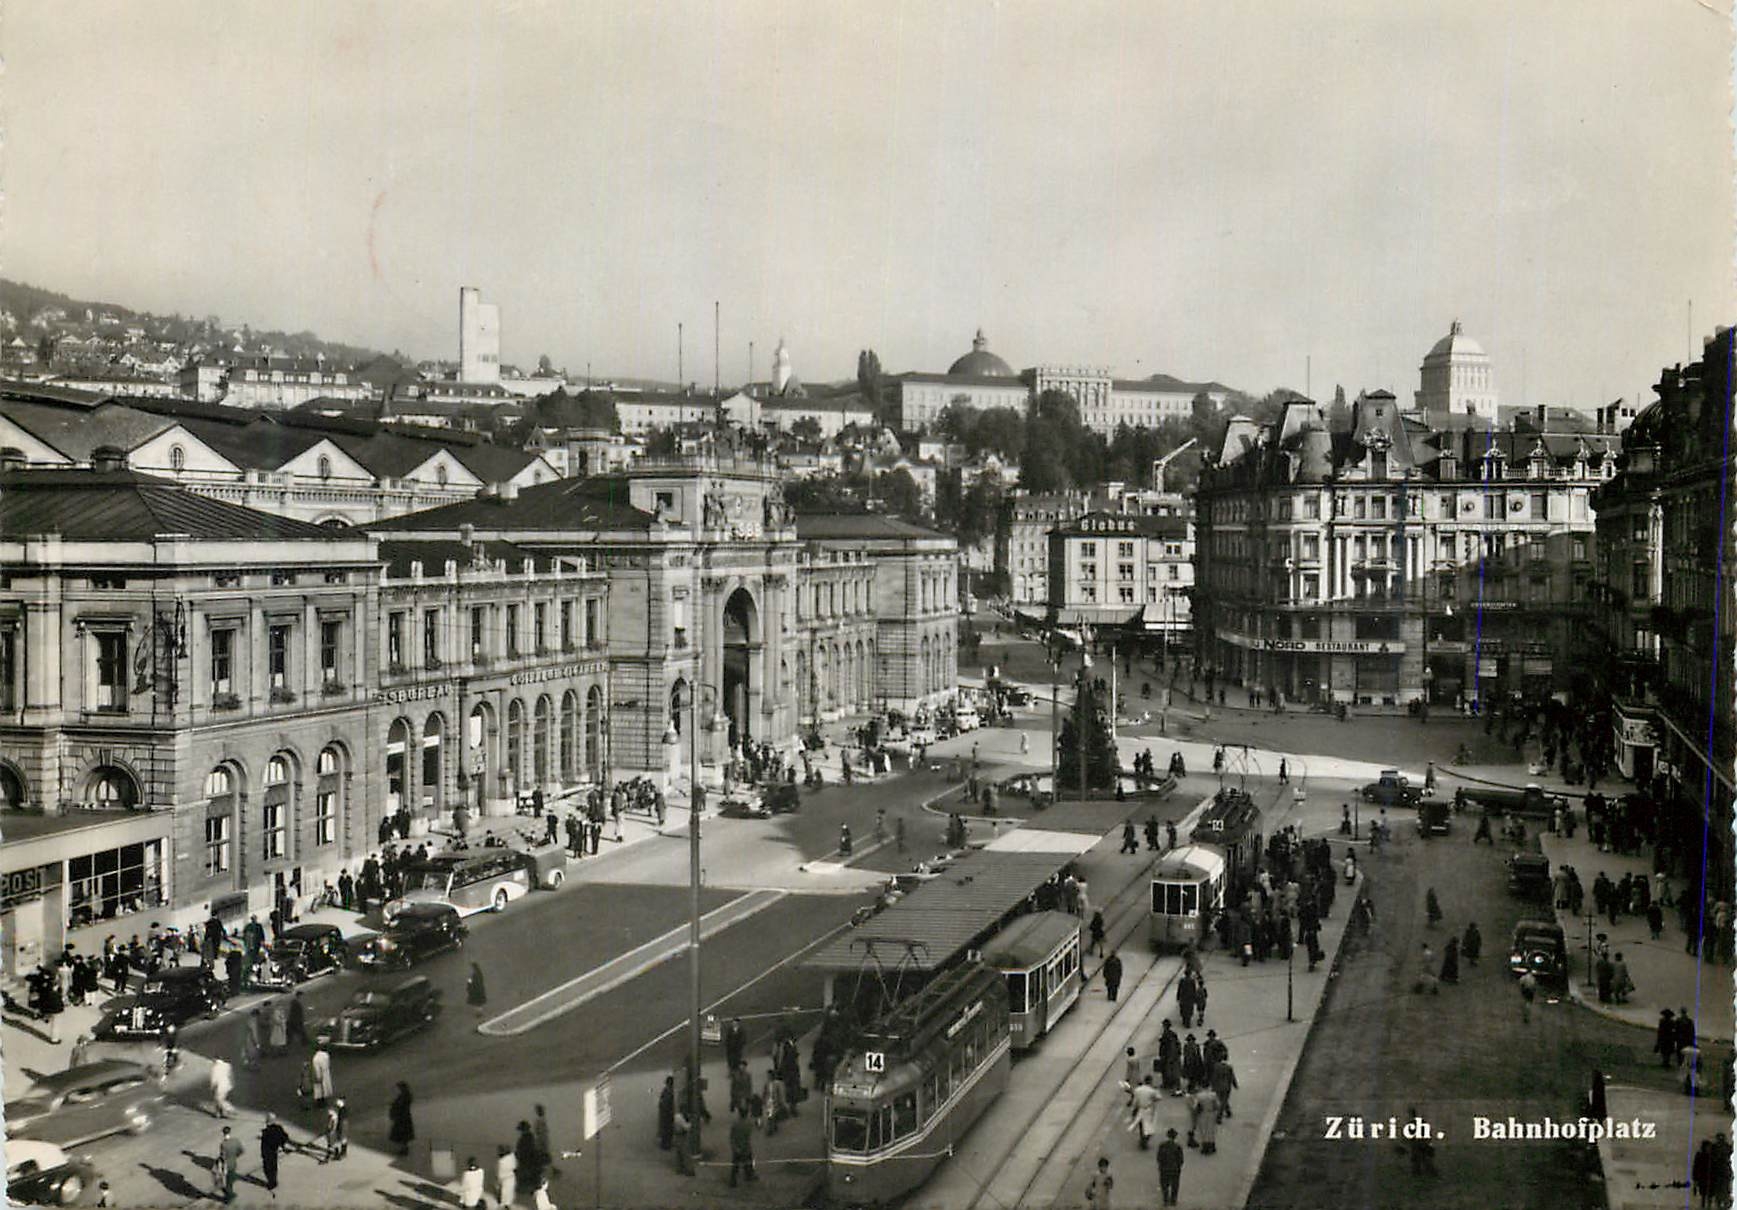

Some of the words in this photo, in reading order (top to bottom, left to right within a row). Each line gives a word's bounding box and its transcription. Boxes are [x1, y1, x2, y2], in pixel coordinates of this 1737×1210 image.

[1081, 518, 1135, 531] Globus
[1316, 642, 1370, 652] RESTAURANT
[868, 1054, 882, 1070] 14
